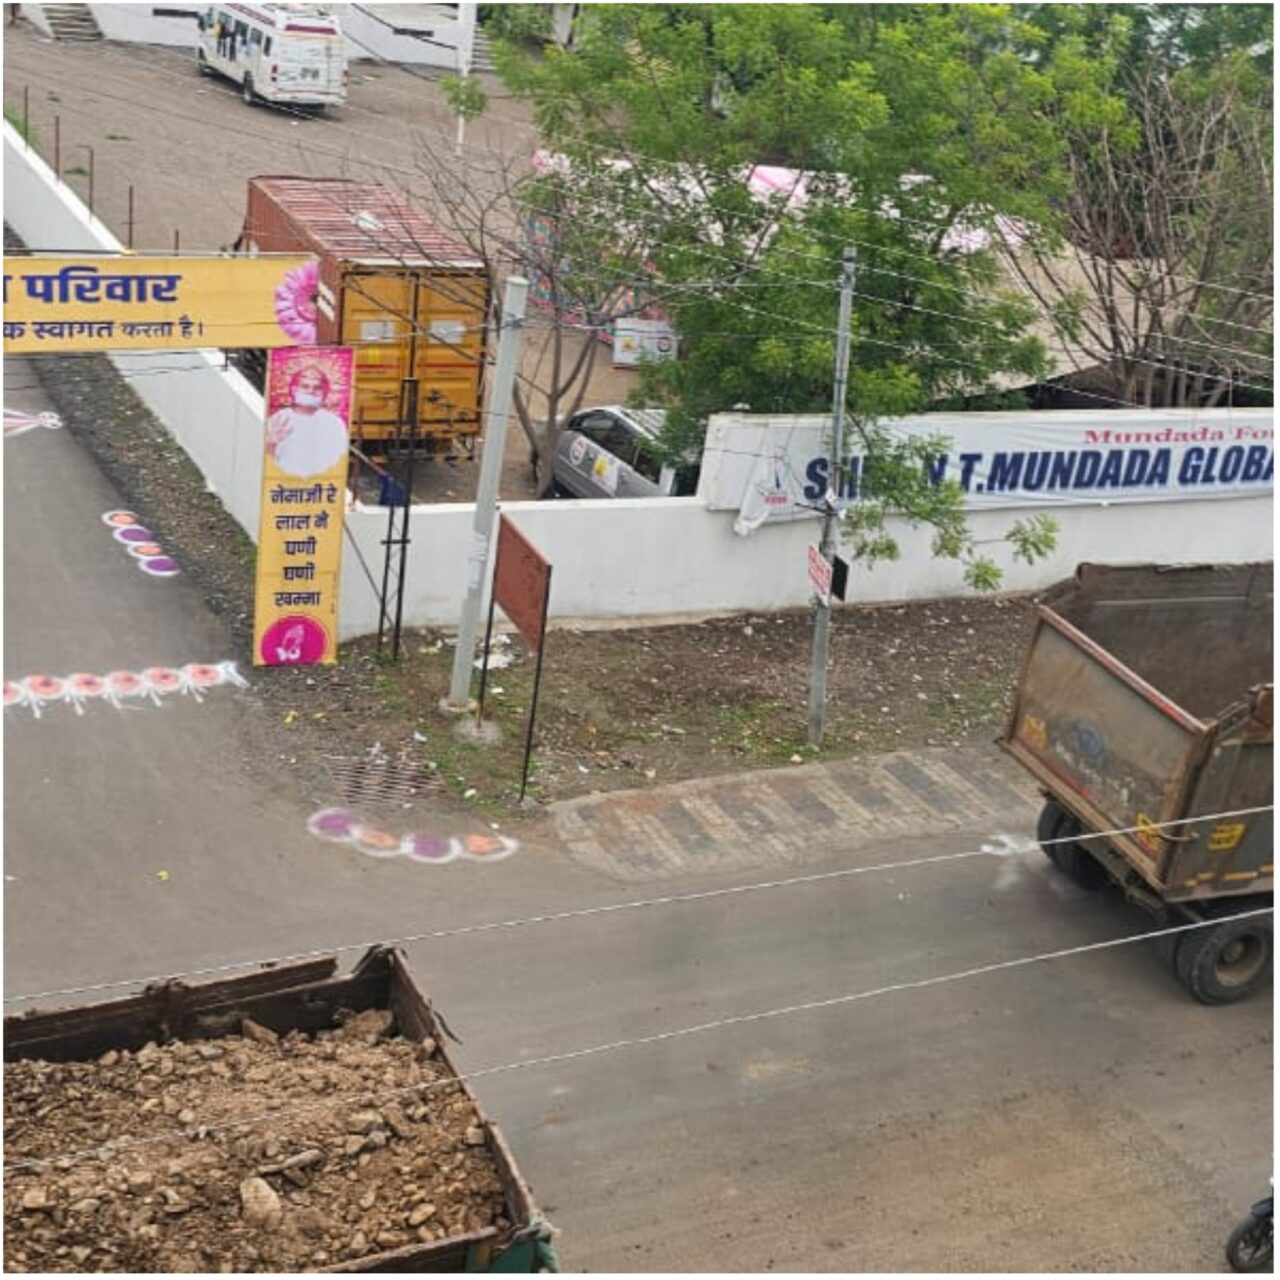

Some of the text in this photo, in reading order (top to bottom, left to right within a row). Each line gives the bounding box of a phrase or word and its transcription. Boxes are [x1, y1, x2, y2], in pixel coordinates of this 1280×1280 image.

[20, 266, 182, 303] परिवार
[31, 322, 114, 339] स्वागत
[121, 322, 174, 338] करता
[1084, 427, 1226, 444] Mundada
[270, 483, 337, 504] नेमाजी रे
[274, 510, 329, 530] लाल ने
[273, 592, 322, 606] खम्मा
